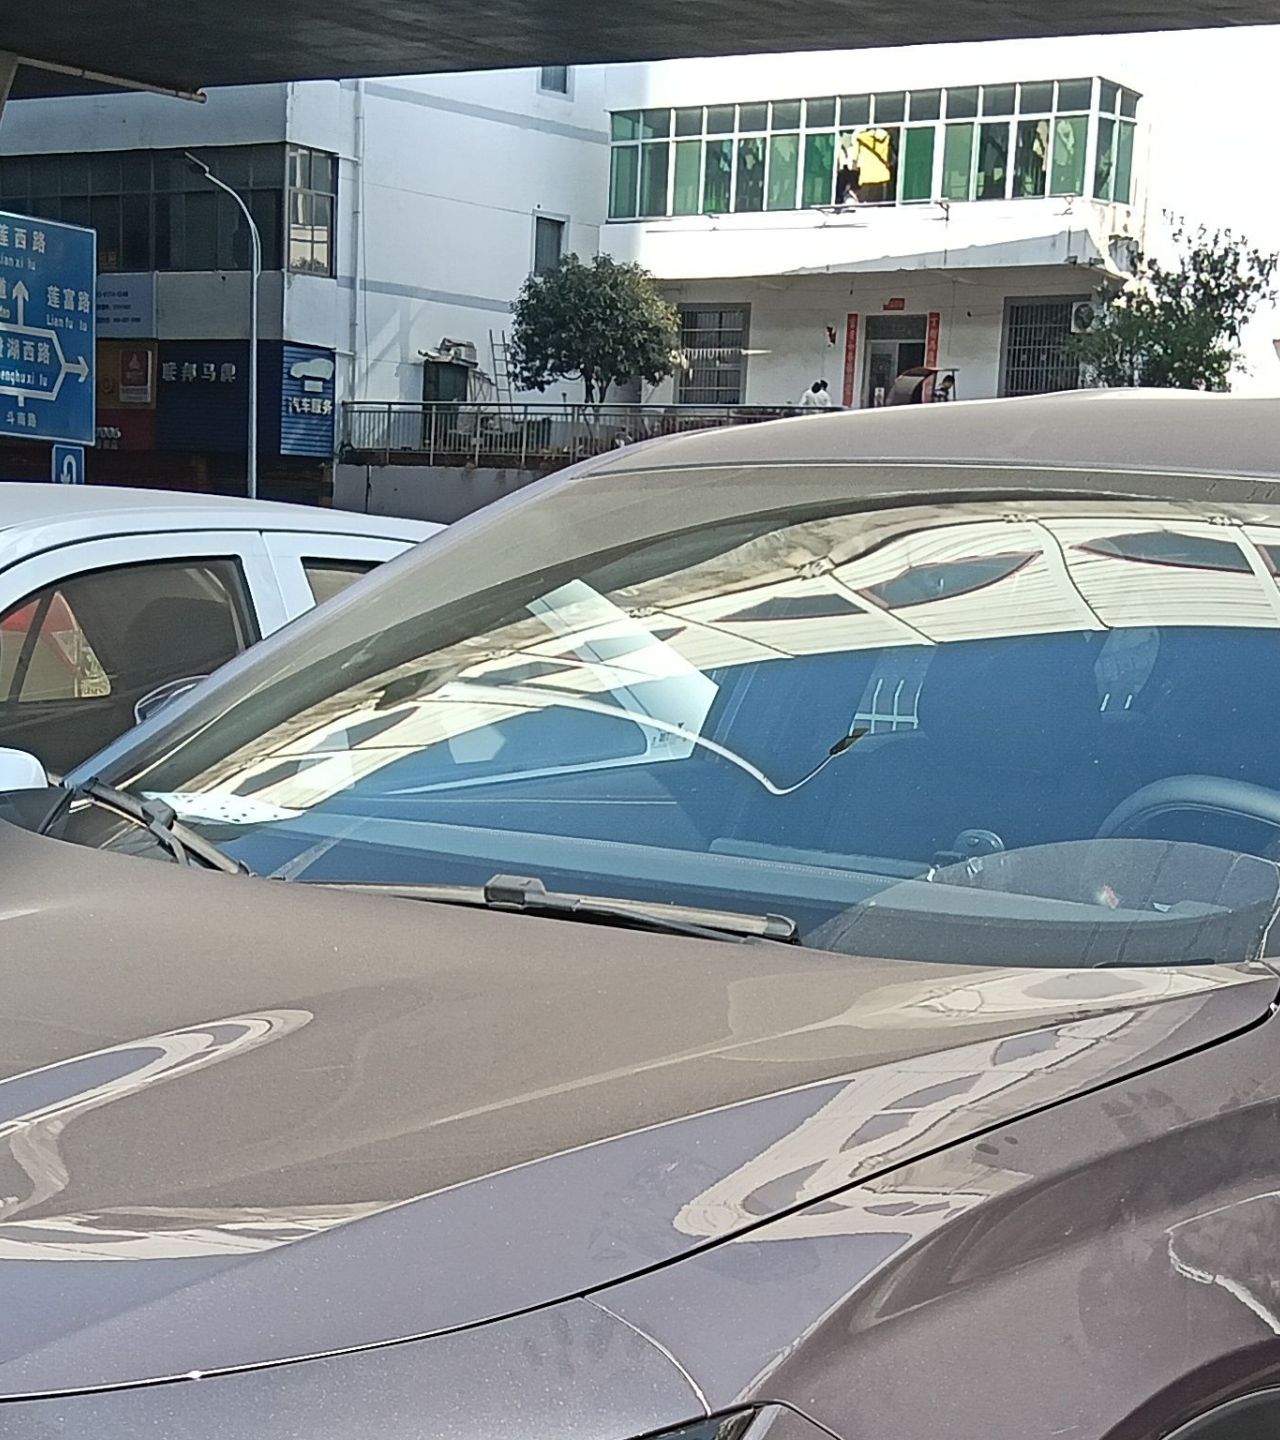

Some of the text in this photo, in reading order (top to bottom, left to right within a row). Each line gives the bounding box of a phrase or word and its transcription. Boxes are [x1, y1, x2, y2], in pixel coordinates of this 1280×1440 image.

[47, 285, 91, 314] 莲富路
[287, 396, 333, 416] 汽车服务
